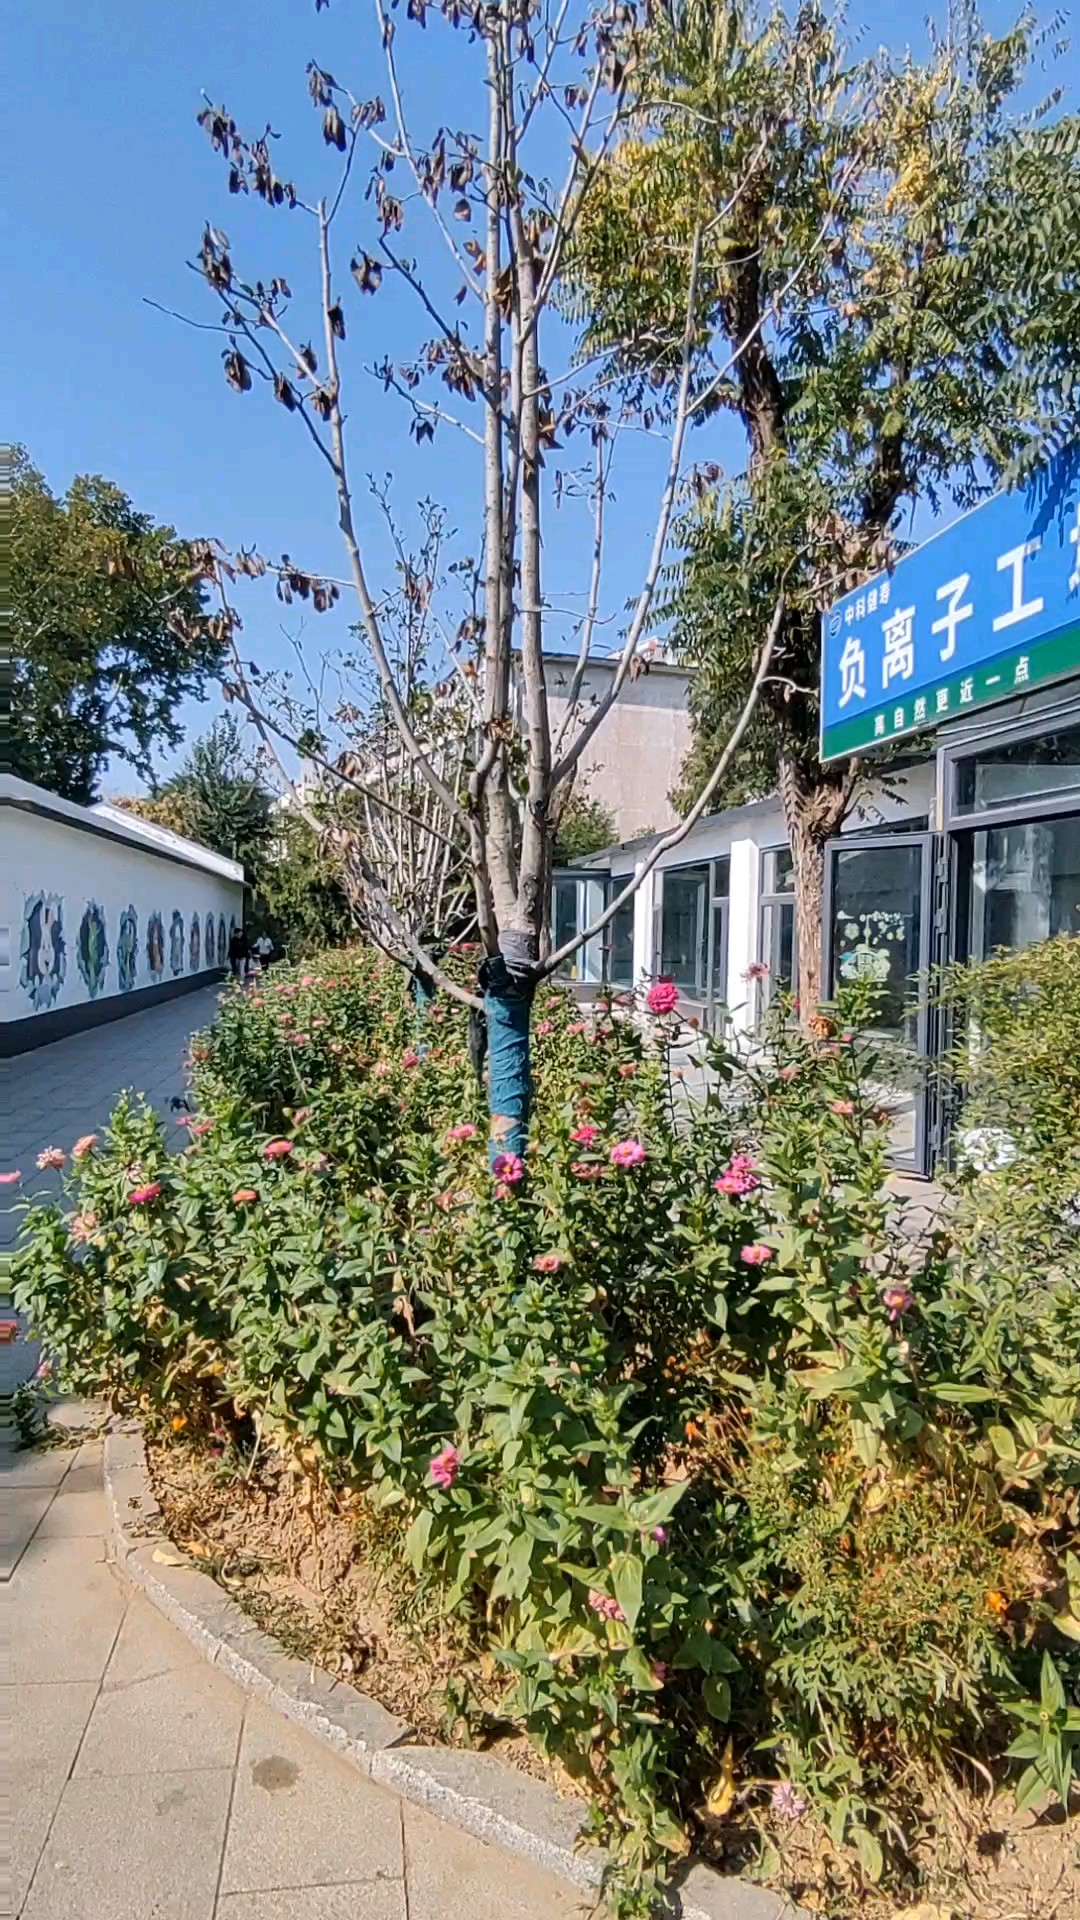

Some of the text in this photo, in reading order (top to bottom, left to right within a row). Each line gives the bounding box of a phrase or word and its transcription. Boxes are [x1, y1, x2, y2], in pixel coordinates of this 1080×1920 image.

[838, 502, 1080, 708] 负离子工
[874, 656, 1029, 736] 离自然更近一点
